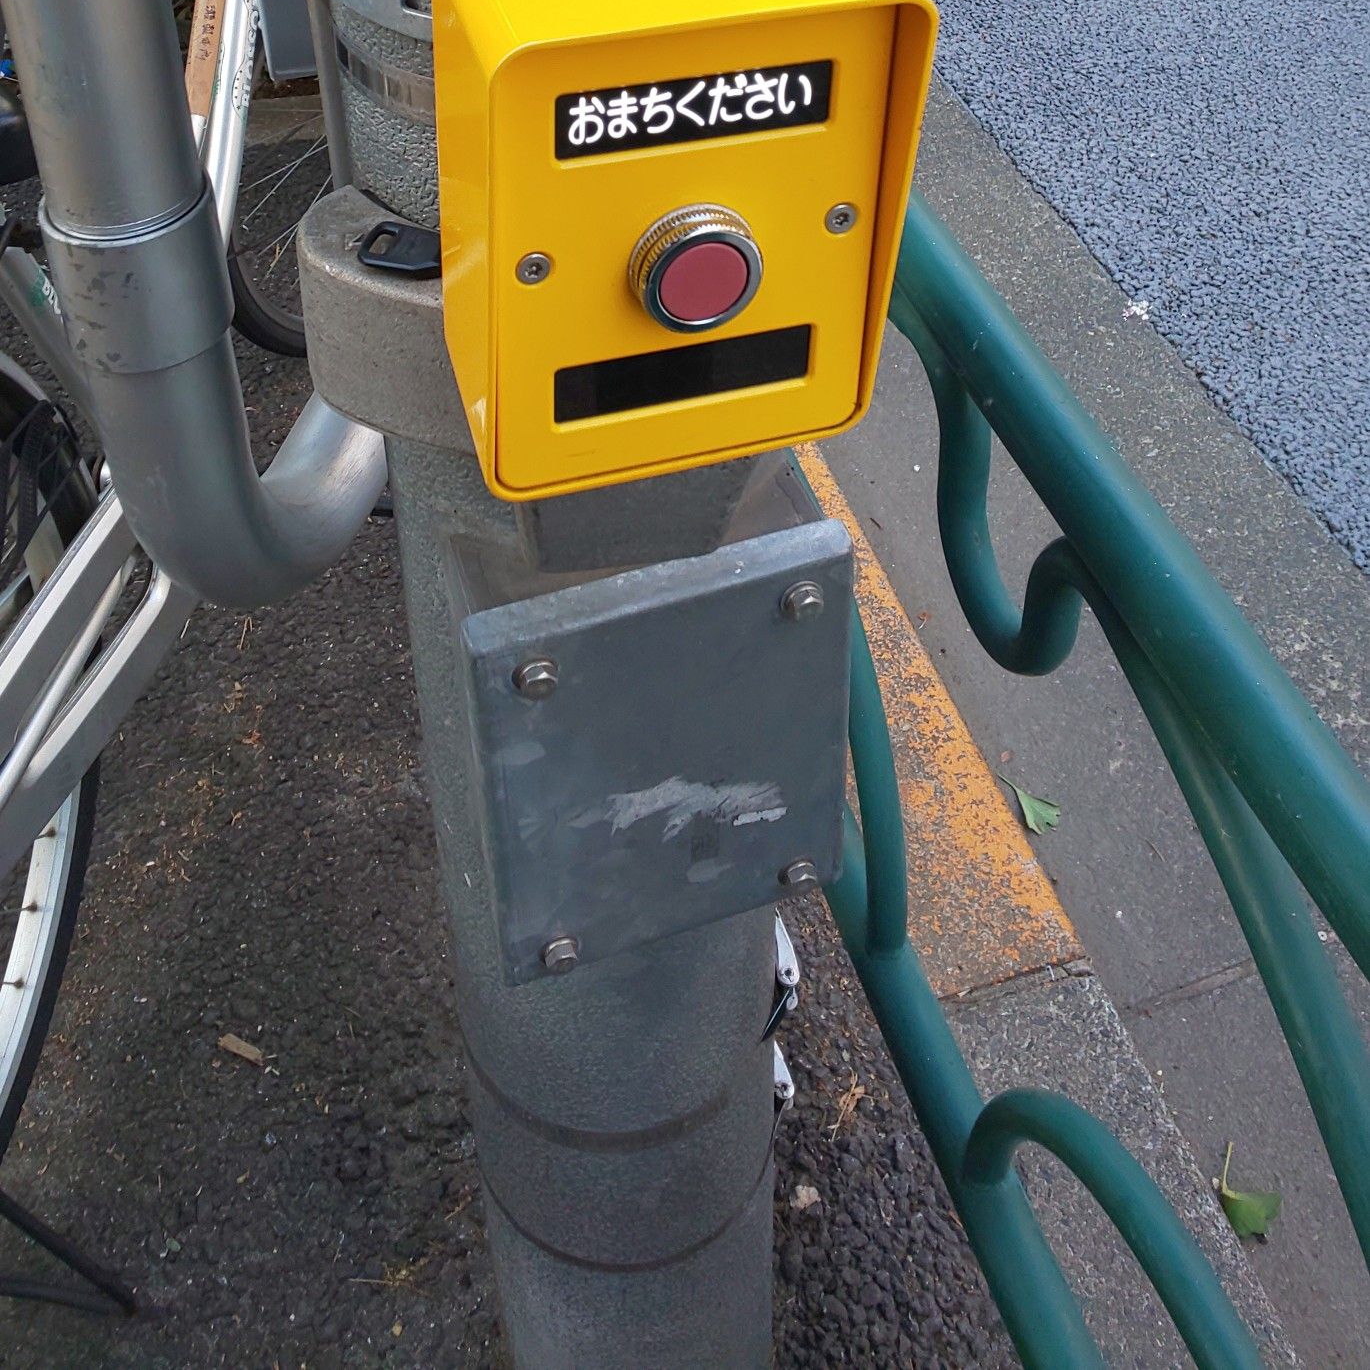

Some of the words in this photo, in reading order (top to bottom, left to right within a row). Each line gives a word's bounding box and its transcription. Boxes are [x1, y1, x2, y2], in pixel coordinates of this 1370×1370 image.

[568, 73, 813, 146] おまちください
